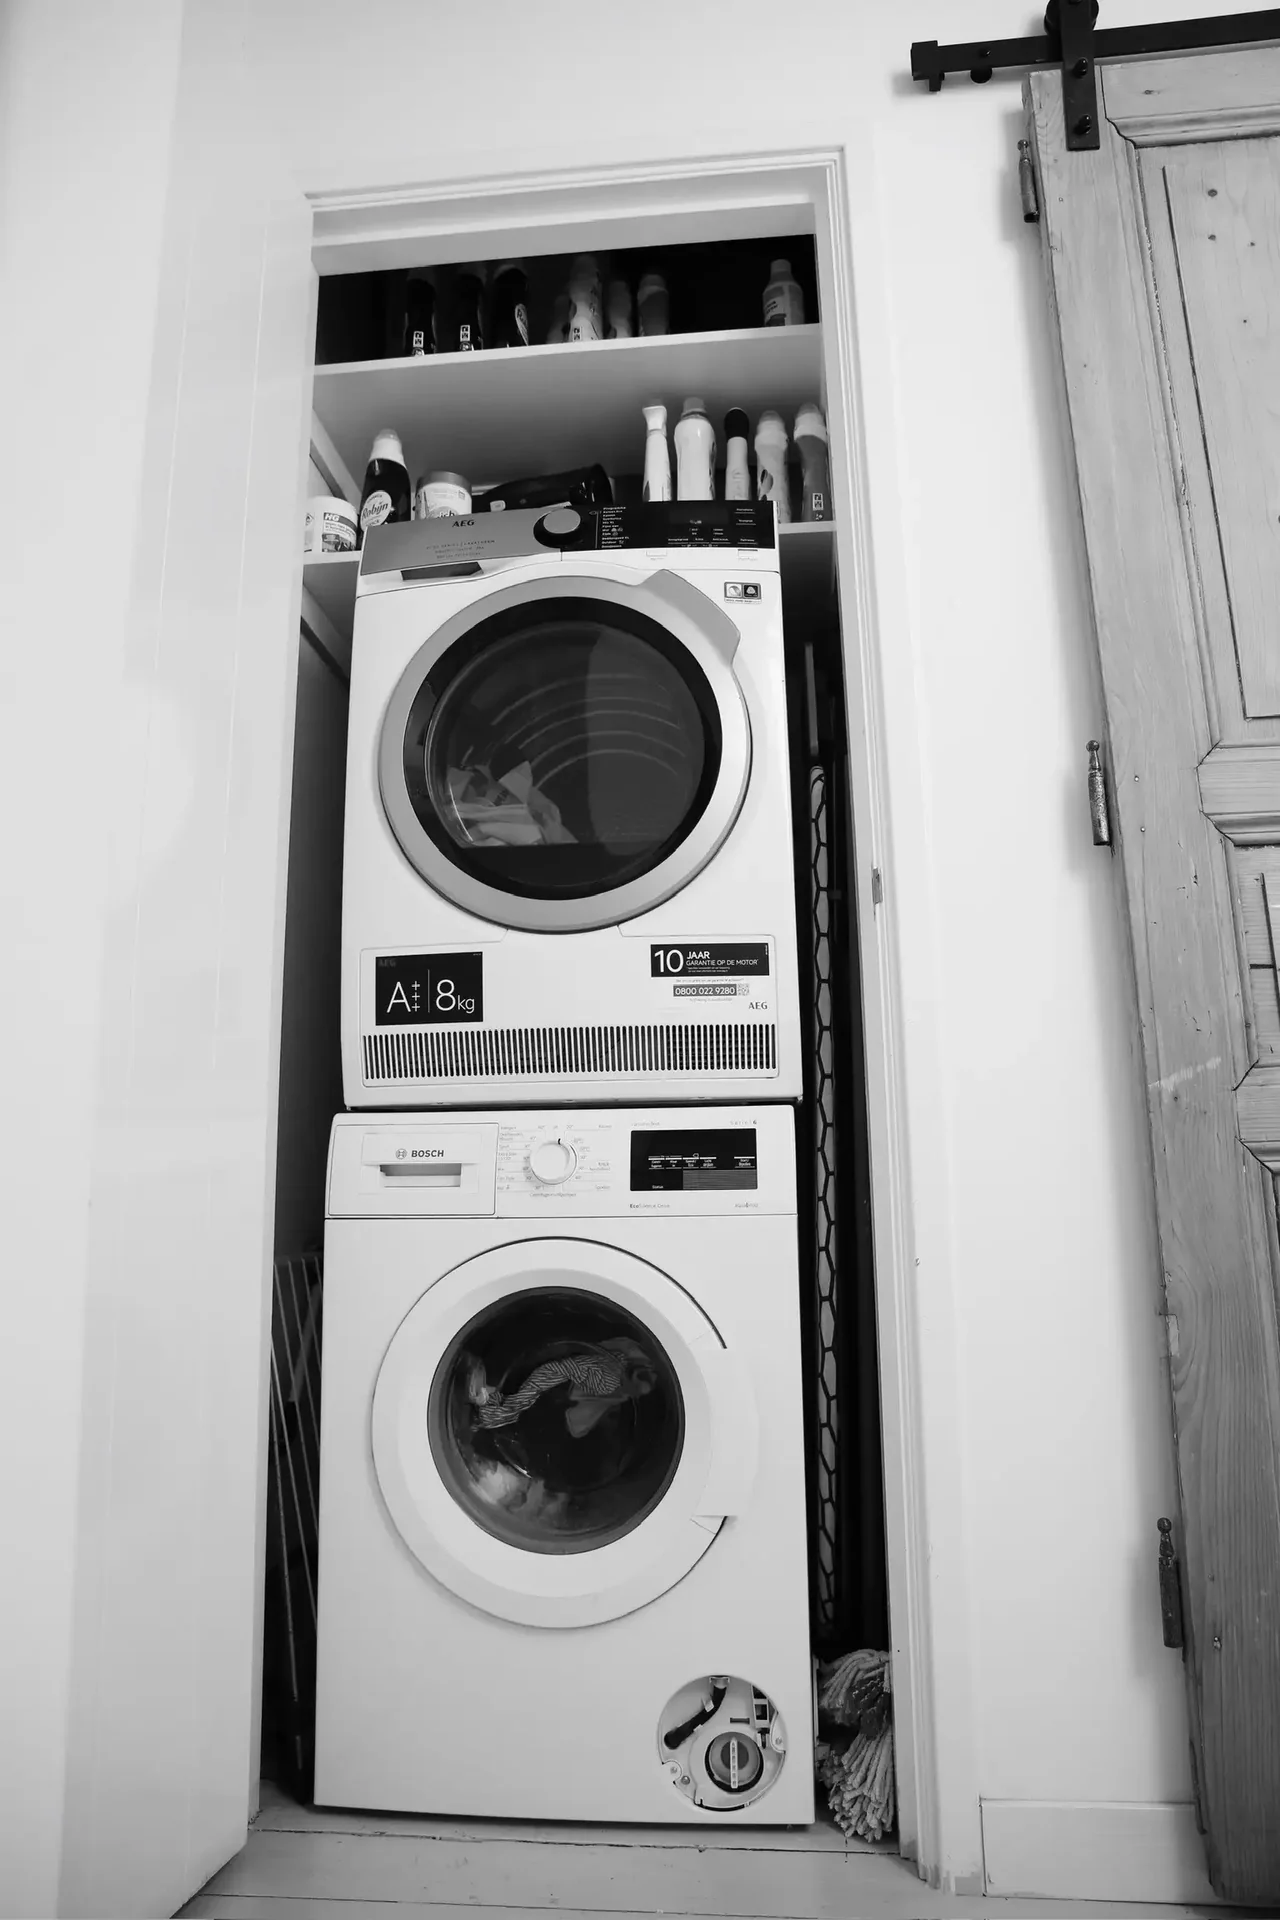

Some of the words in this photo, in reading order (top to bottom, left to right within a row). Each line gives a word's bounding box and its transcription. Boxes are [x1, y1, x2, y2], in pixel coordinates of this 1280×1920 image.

[362, 502, 389, 519] Robijn
[324, 513, 340, 522] HG
[452, 520, 475, 528] AEG
[686, 951, 710, 959] JAAR
[654, 949, 684, 973] 10
[675, 987, 697, 995] 0800
[698, 986, 713, 995] 022
[715, 986, 735, 995] 9280
[748, 1001, 768, 1010] AEG
[411, 1149, 444, 1158] BOSCH
